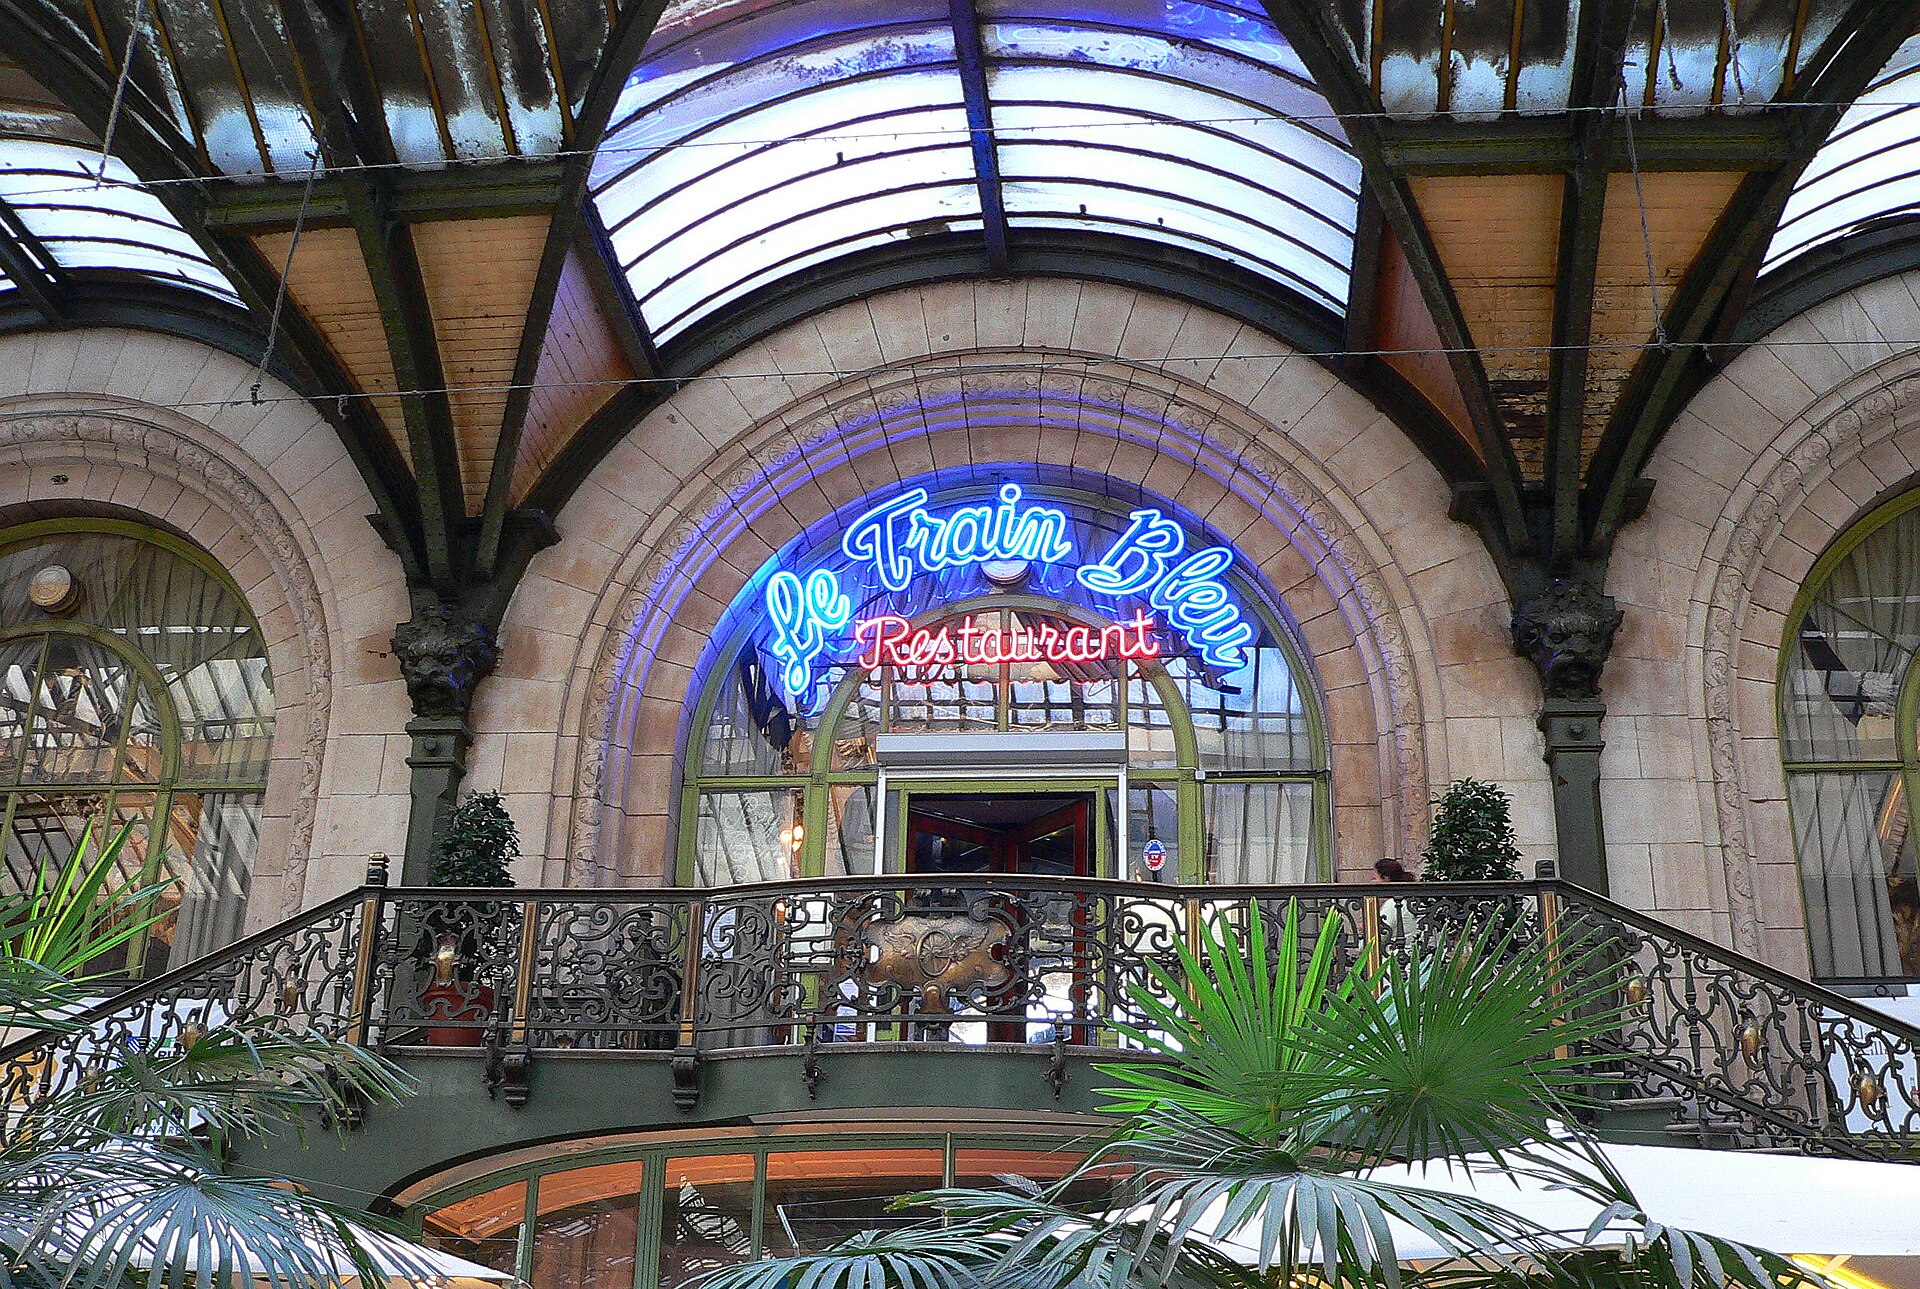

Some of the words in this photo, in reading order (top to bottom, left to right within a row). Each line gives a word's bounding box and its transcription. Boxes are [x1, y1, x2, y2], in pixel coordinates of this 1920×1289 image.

[766, 568, 851, 695] Le
[842, 482, 1072, 592] Train
[1076, 509, 1252, 668] Bleu
[854, 608, 1160, 669] Restaurant
